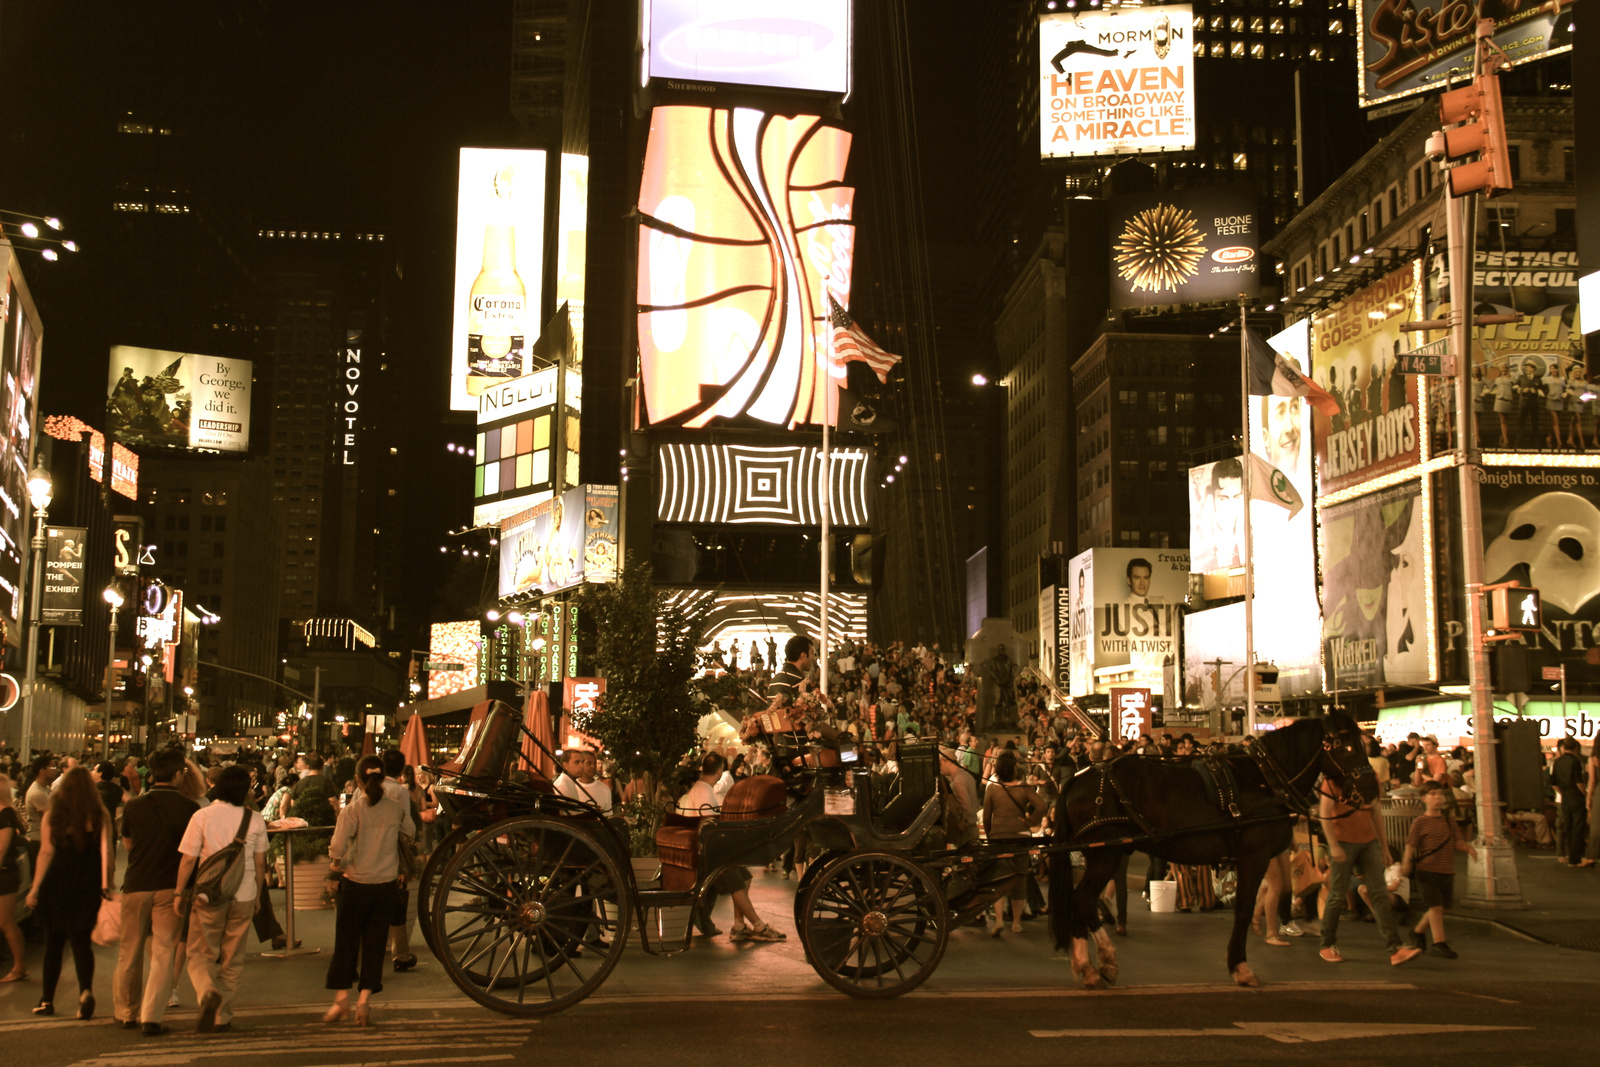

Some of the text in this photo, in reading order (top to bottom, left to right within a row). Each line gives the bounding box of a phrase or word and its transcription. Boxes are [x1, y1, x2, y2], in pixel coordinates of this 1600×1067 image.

[1427, 53, 1435, 61] A
[1436, 36, 1468, 56] DIVINE
[1509, 6, 1541, 24] COMEDY
[667, 81, 716, 93] SHERWOOD
[1051, 91, 1185, 111] ON BROADWAY.
[1051, 105, 1185, 123] SOMETHING LIKE
[1051, 125, 1069, 142] A
[1214, 214, 1252, 227] BUONE
[1217, 225, 1251, 236] FESTE.
[1221, 250, 1250, 259] Barilla
[1352, 268, 1415, 316] CROWD
[474, 296, 521, 312] Corona
[484, 310, 514, 320] Extra
[1320, 316, 1362, 352] GOES
[1494, 341, 1571, 351] IF YOU CAN
[216, 362, 231, 377] By
[1401, 356, 1438, 373] W 46 ST
[199, 373, 246, 392] George,
[214, 390, 231, 400] we
[204, 400, 237, 414] did it.
[343, 348, 361, 465] NOVOTEL
[200, 420, 240, 432] LEADERSHIP
[1323, 403, 1416, 480] JERSEY BOYS
[1525, 470, 1578, 489] belongs
[586, 484, 592, 493] 9
[46, 561, 82, 569] POMPEII
[46, 573, 64, 581] THE
[45, 585, 80, 593] EXHIBIT
[553, 606, 561, 642] OLIVE
[1101, 603, 1187, 637] JUSTI
[1102, 640, 1174, 653] WITH A TWIST.
[551, 644, 560, 682] GARDE
[1121, 691, 1146, 741] tkts
[1564, 712, 1600, 739] sb
